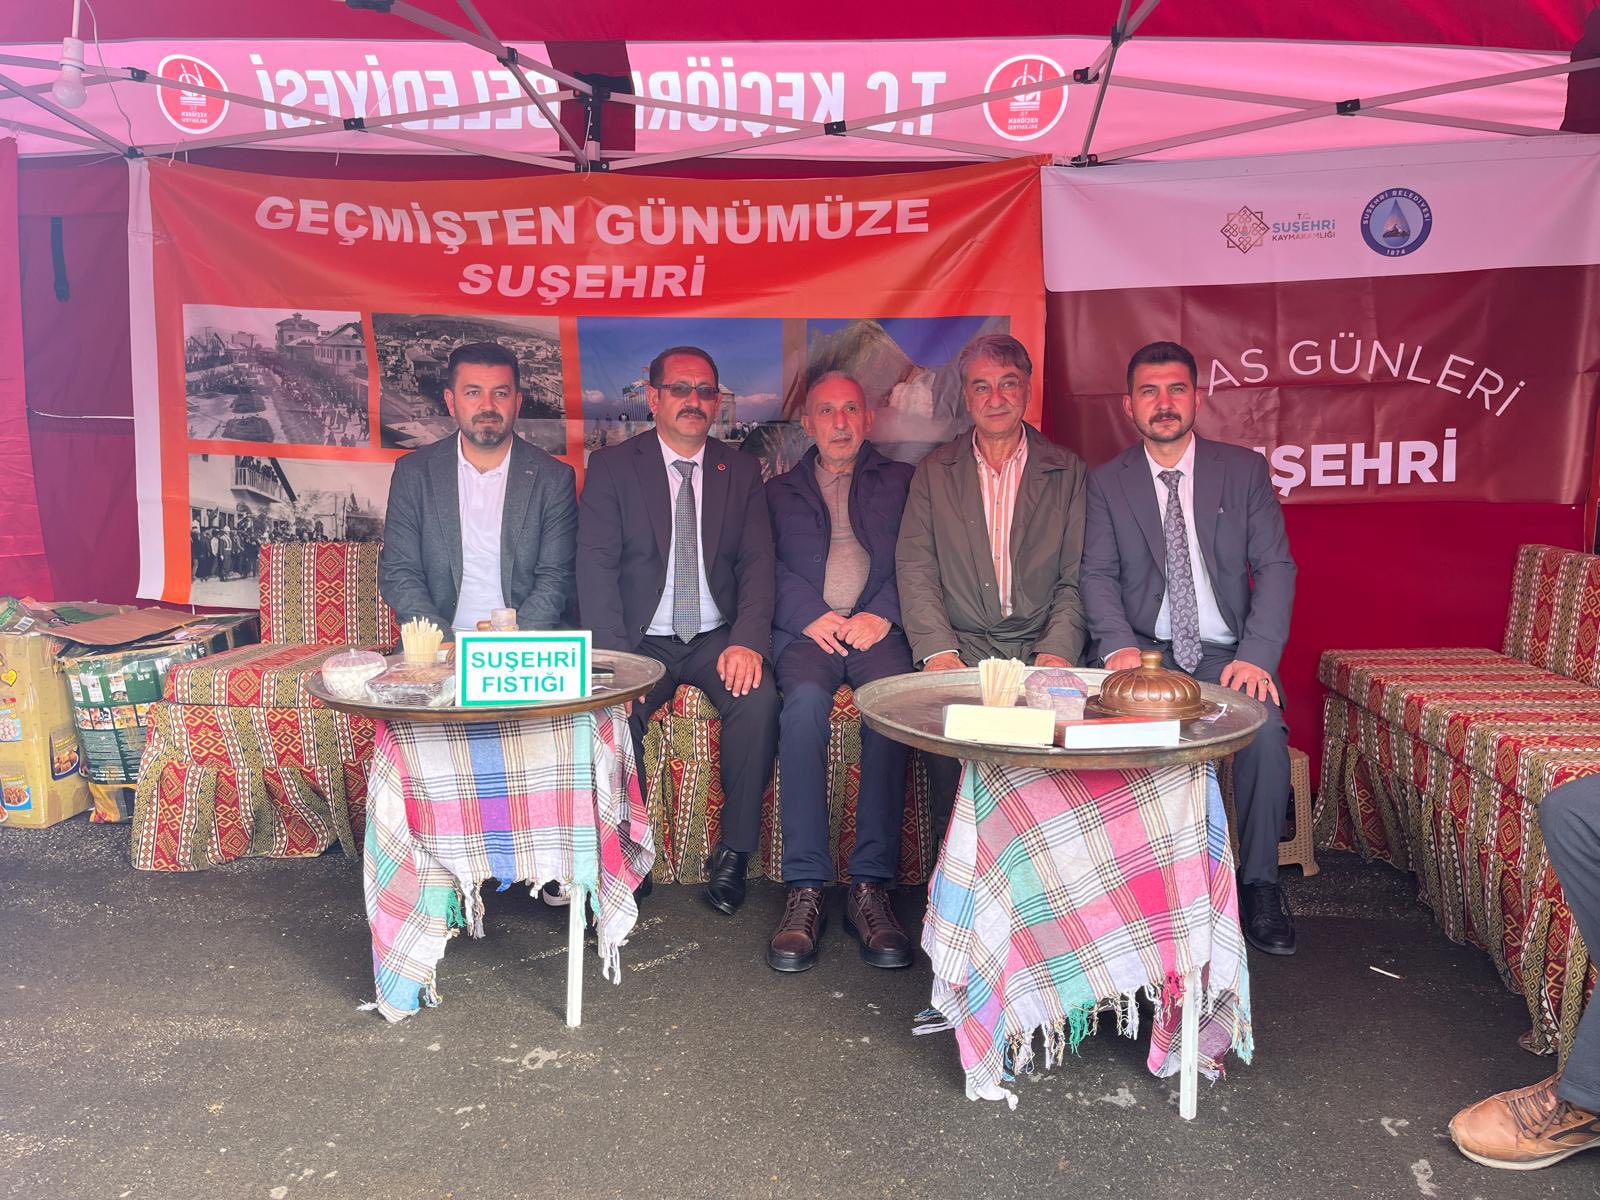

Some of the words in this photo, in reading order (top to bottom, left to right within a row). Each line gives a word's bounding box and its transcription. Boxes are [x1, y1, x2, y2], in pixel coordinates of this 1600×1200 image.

[255, 196, 576, 255] GEÇMİŞTEN
[595, 194, 930, 246] GÜNÜMÜZE
[458, 255, 706, 306] SUŞEHRİ
[1288, 332, 1526, 417] GÜNLERİ
[1253, 427, 1457, 497] ŞEHRİ
[471, 648, 576, 672] SUŞEHRİ
[482, 672, 564, 692] FISTIĞI
